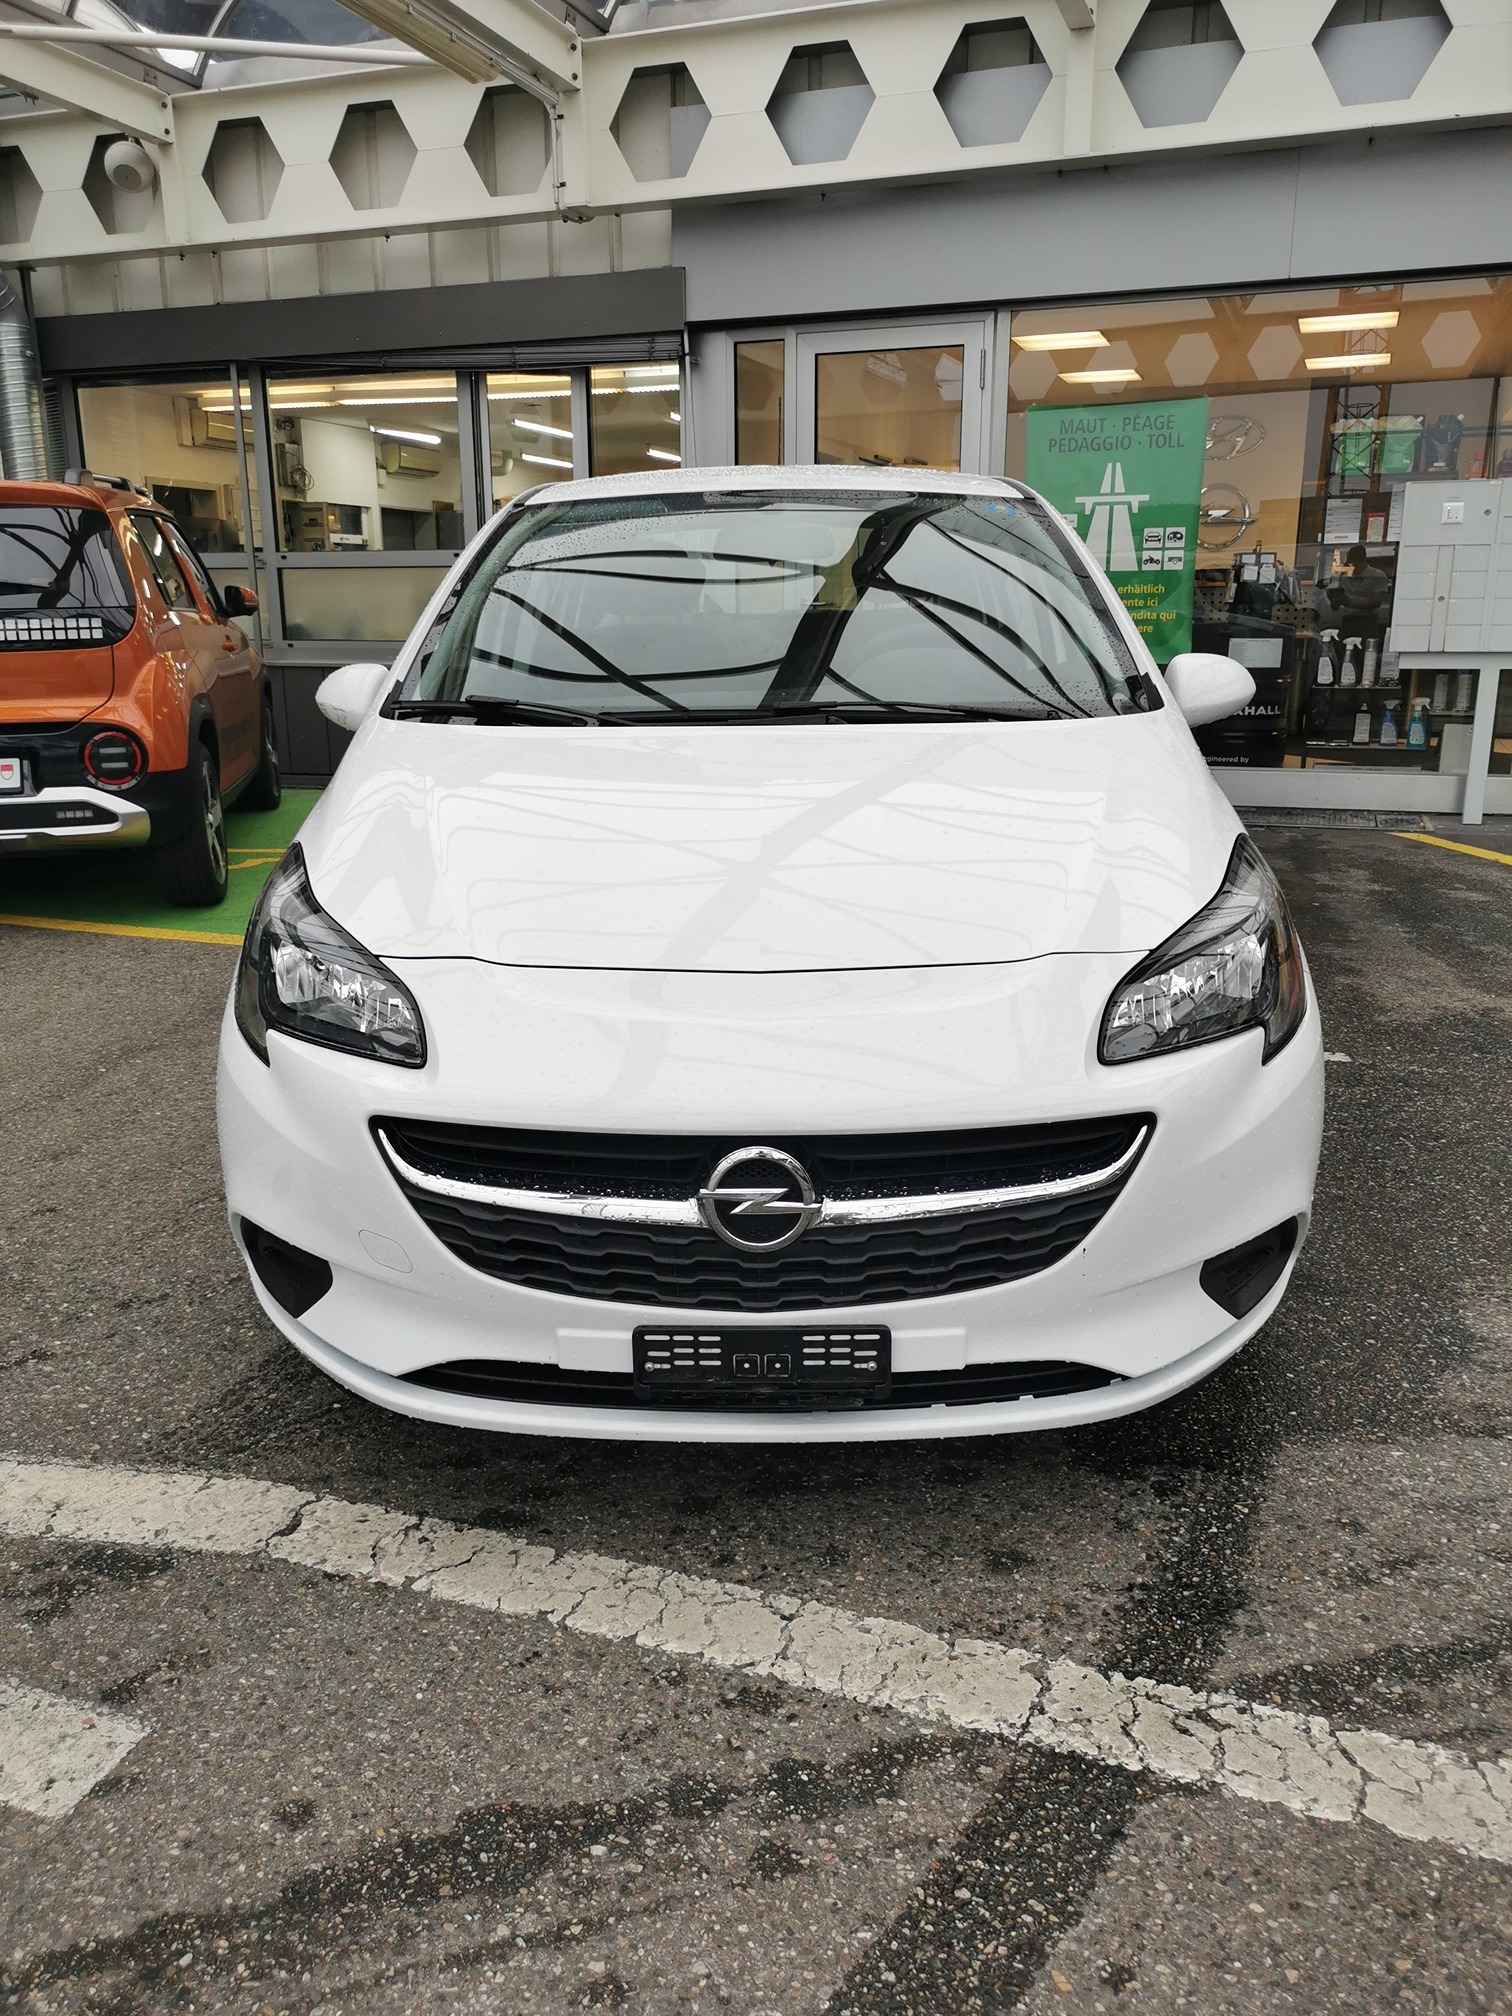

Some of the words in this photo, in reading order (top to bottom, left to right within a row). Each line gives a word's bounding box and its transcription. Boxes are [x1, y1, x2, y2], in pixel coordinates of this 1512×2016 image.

[1059, 418, 1107, 435] MAUT
[1122, 412, 1175, 432] PÉAGE
[1048, 434, 1132, 453] PEDAGGIO
[1147, 433, 1185, 449] TOLL
[1117, 583, 1166, 594] erhältlich
[1122, 598, 1145, 607] ente
[1147, 597, 1159, 607] ici
[1130, 609, 1157, 620] ndita
[1159, 610, 1177, 622] qui
[1137, 625, 1153, 633] ere
[1240, 756, 1250, 764] by
